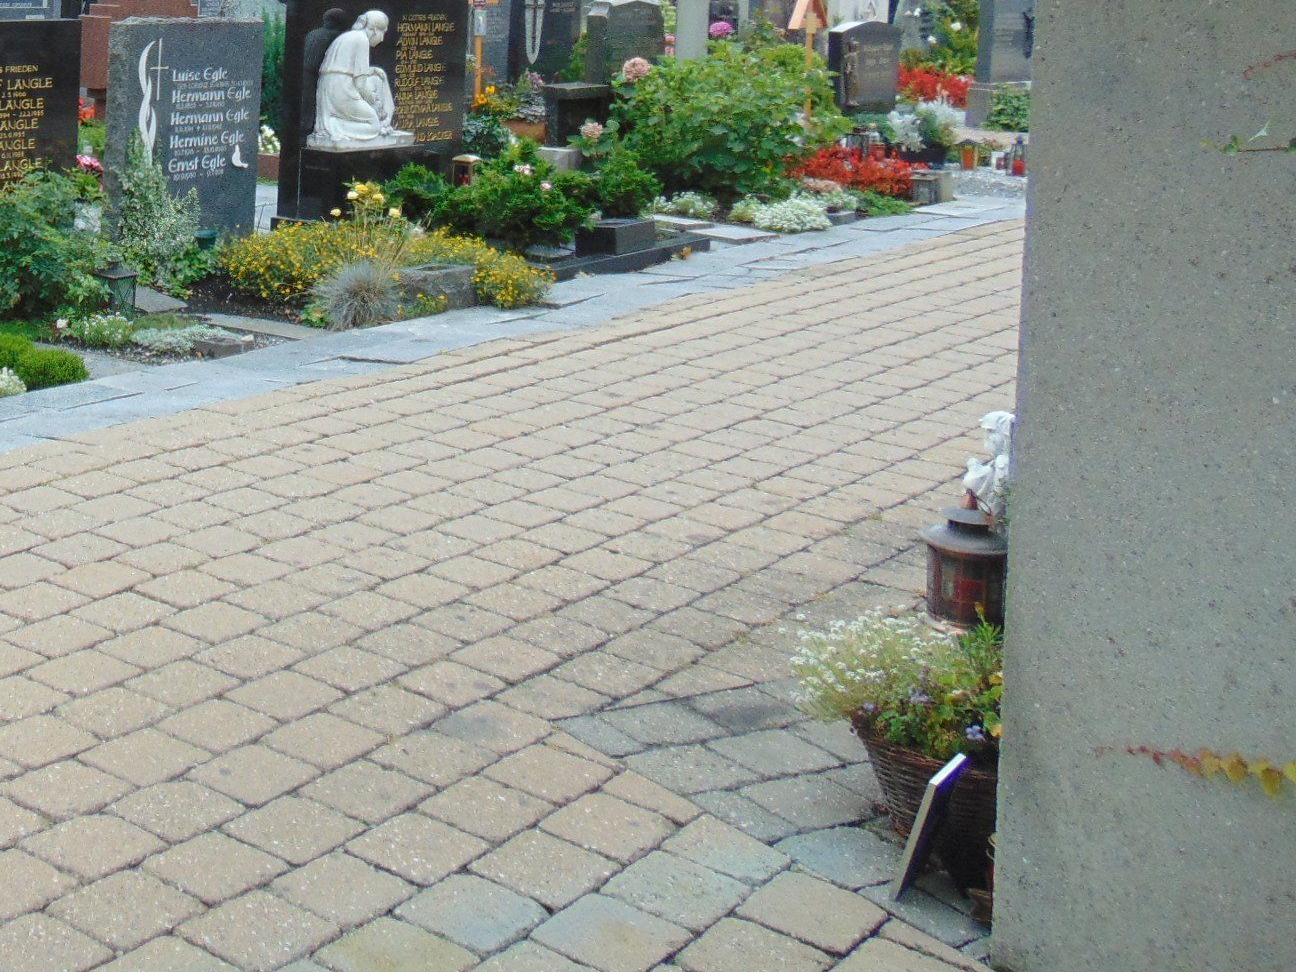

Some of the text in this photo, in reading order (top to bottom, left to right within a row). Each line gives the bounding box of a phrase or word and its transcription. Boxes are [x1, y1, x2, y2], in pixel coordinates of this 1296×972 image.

[5, 65, 39, 74] FRIEDEN
[172, 67, 228, 82] Luise Egle
[171, 86, 251, 103] Hermann Egle
[170, 108, 250, 126] Hermann Egle
[169, 130, 245, 149] Hermine Egle
[168, 155, 200, 174] Ernst
[201, 154, 227, 170] Egle
